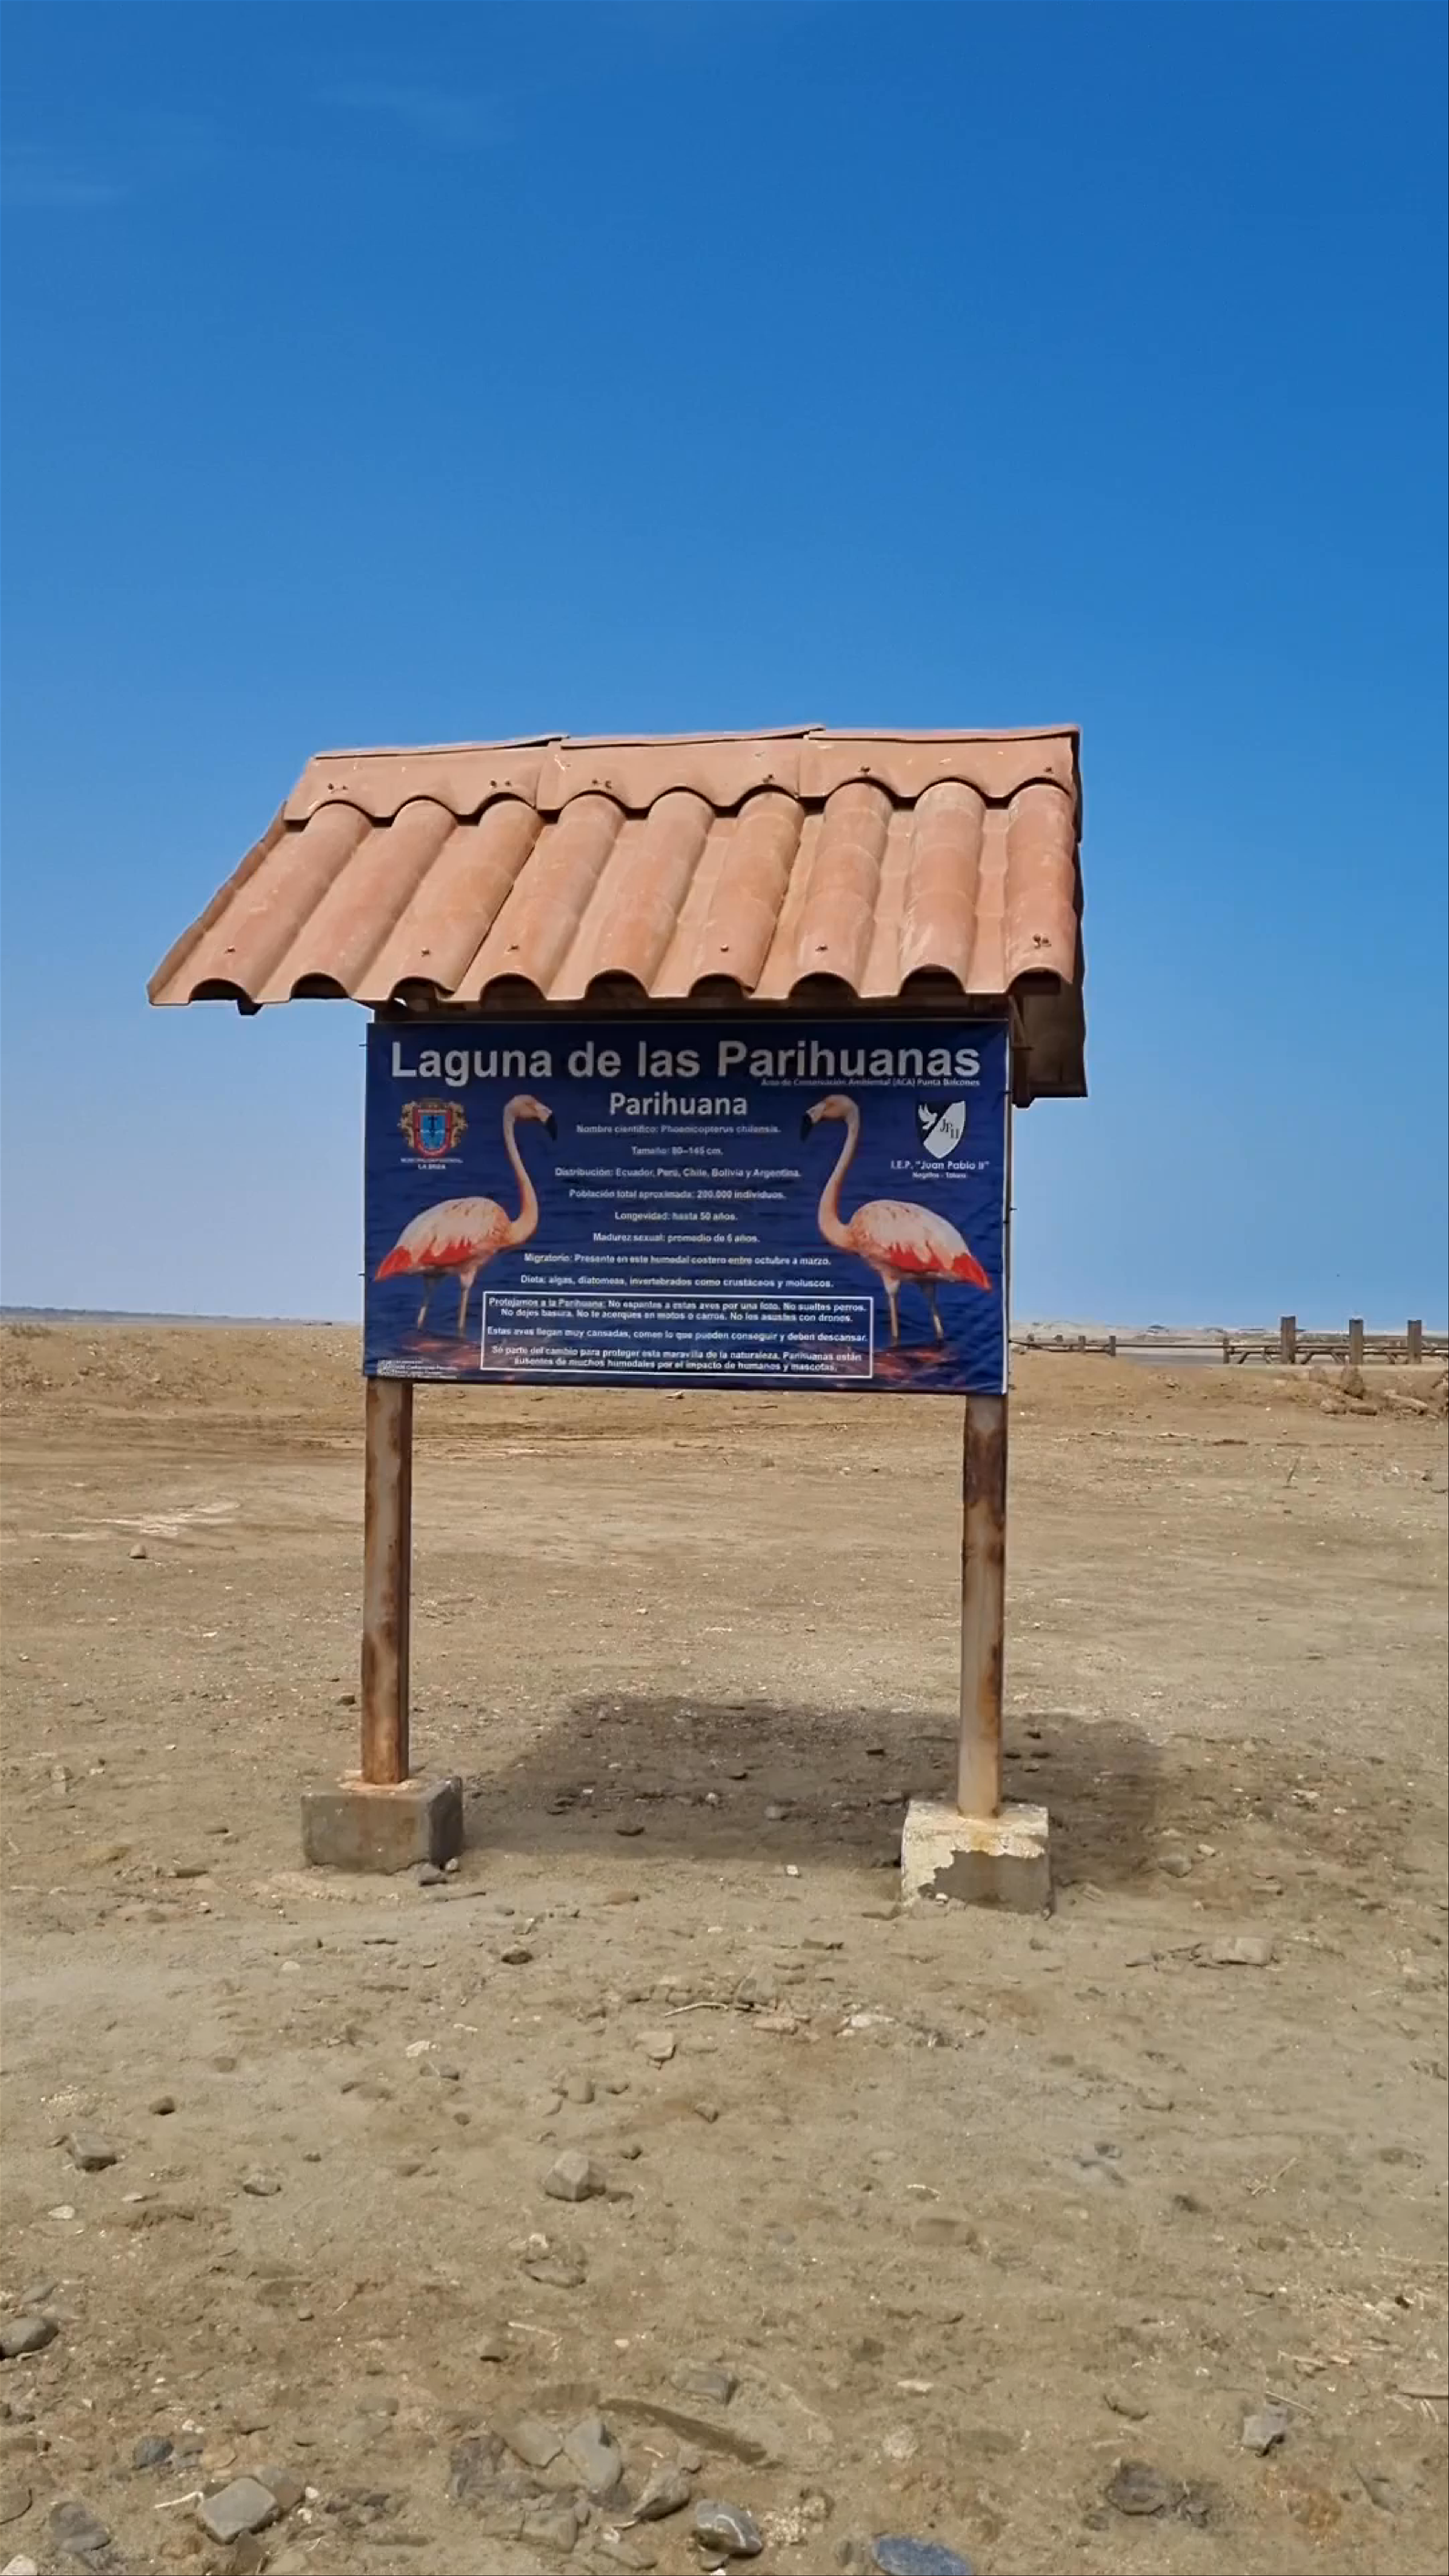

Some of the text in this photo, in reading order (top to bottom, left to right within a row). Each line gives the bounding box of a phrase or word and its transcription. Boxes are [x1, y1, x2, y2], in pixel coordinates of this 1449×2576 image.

[392, 1040, 980, 1087] Laguna de las Parihuanas
[610, 1092, 748, 1115] Parihuana
[948, 1161, 975, 1170] Pablo
[616, 1168, 655, 1178] Ecuador,
[683, 1168, 709, 1178] Chile,
[712, 1168, 743, 1177] Bolivia
[754, 1169, 801, 1178] Argentina.
[569, 1189, 615, 1198] Población
[617, 1190, 636, 1198] total
[615, 1212, 670, 1221] Longevidad:
[713, 1212, 738, 1221] años.
[667, 1234, 711, 1244] promedio
[734, 1234, 760, 1243] años.
[524, 1253, 571, 1263] Migratorio:
[575, 1254, 615, 1263] Presente
[755, 1256, 790, 1265] octubre
[521, 1275, 546, 1283] Dieta:
[548, 1275, 576, 1285] algas,
[630, 1277, 692, 1286] invertebrados
[785, 1279, 834, 1287] moluscos.
[489, 1298, 538, 1309] Protejamos
[722, 1303, 738, 1312] por
[833, 1304, 867, 1313] perros.
[515, 1309, 540, 1318] dejes
[601, 1311, 642, 1320] acerques
[818, 1313, 853, 1322] drones.
[487, 1326, 511, 1335] Estas
[535, 1328, 563, 1338] llegan
[565, 1330, 584, 1339] muy
[586, 1329, 631, 1338] cansadas,
[675, 1332, 692, 1340] que
[695, 1332, 728, 1340] pueden
[731, 1332, 778, 1341] conseguir
[779, 1334, 785, 1342] y
[817, 1333, 868, 1342] descansar.
[505, 1346, 528, 1356] parte
[580, 1350, 600, 1358] para
[603, 1349, 640, 1359] proteger
[663, 1350, 703, 1359] maravilla
[730, 1351, 780, 1360] naturaleza.
[783, 1351, 834, 1360] Parihuanas
[556, 1358, 567, 1366] de
[569, 1358, 605, 1367] muchos
[657, 1361, 672, 1370] por
[674, 1360, 684, 1369] el
[686, 1361, 722, 1370] impacto
[783, 1363, 789, 1372] y
[791, 1362, 837, 1371] mascotas.
